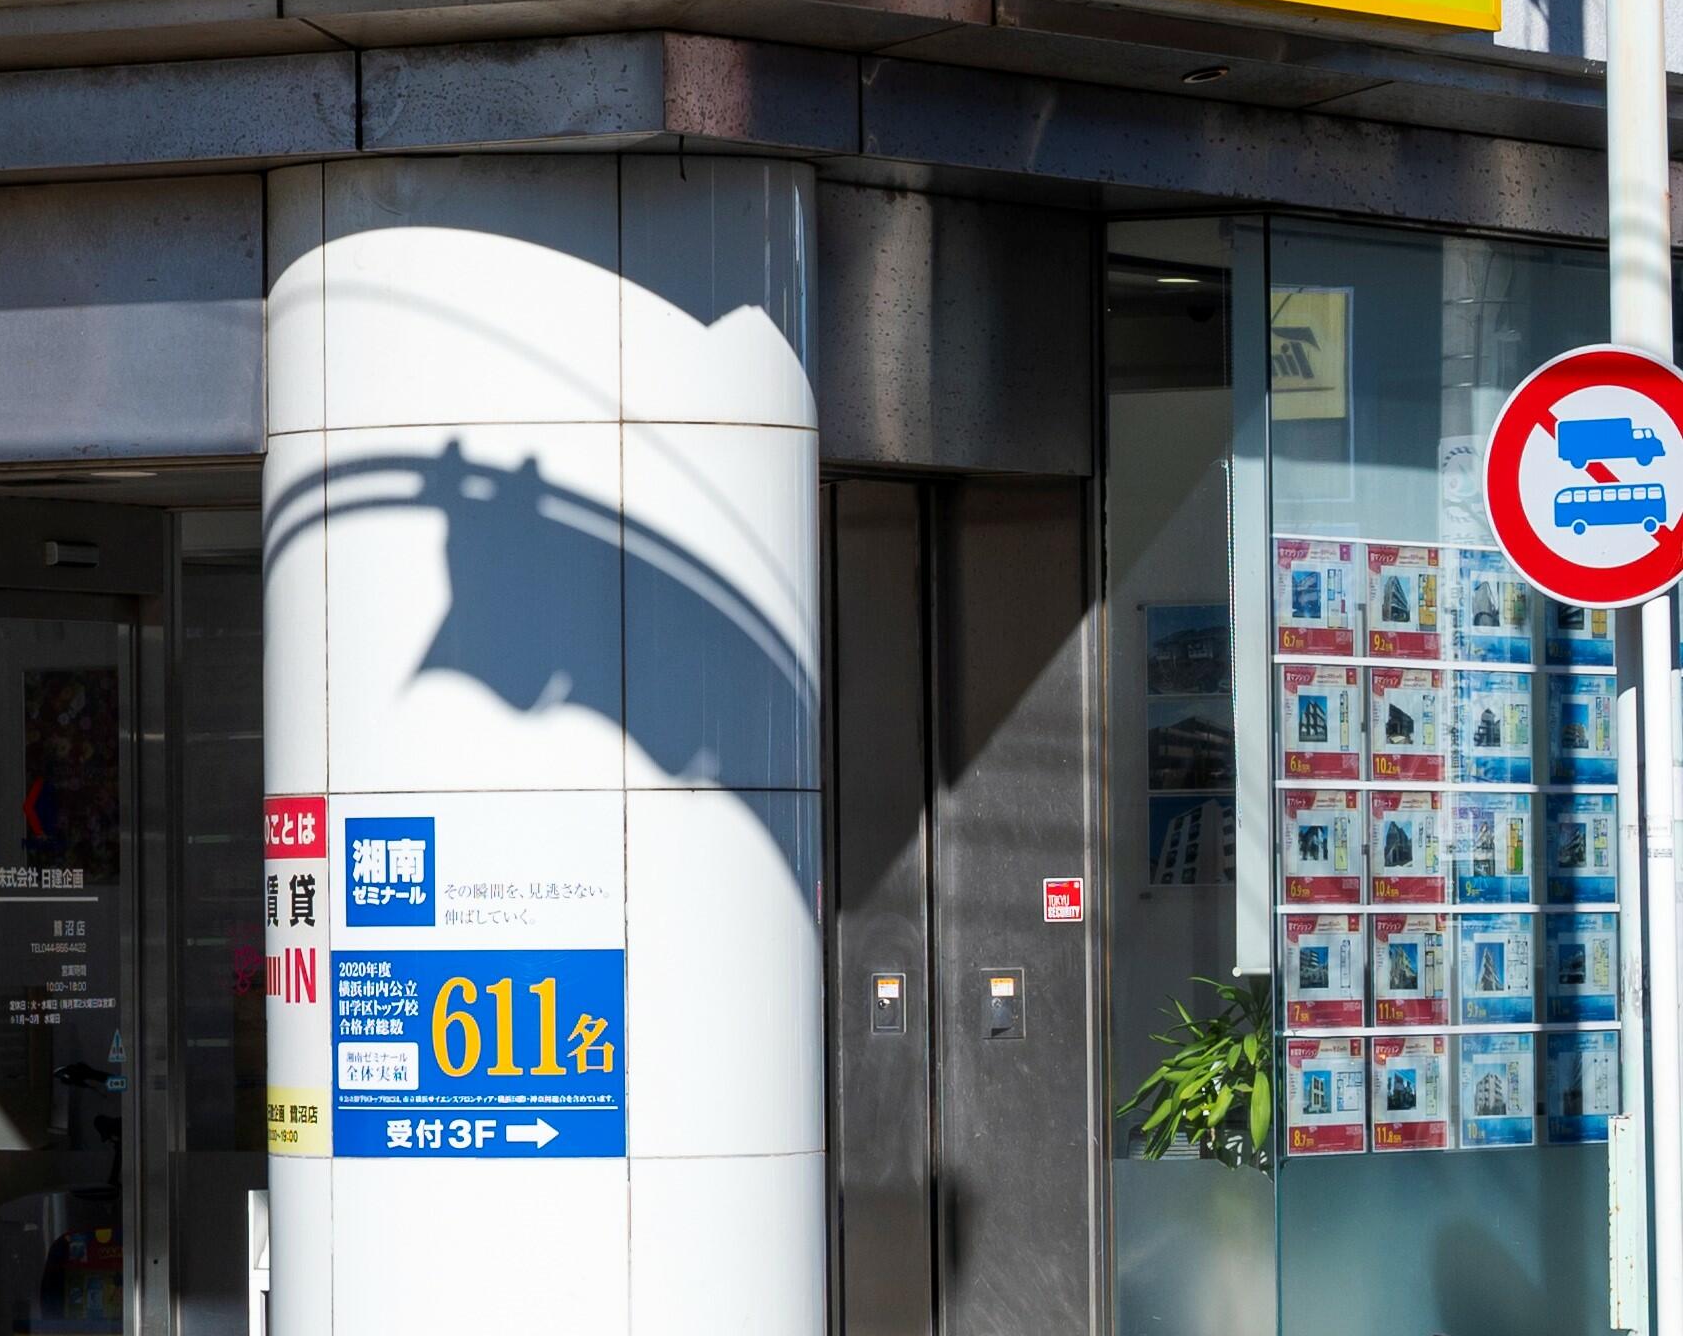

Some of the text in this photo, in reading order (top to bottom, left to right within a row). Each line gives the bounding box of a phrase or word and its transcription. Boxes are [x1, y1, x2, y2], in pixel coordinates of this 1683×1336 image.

[352, 837, 427, 884] 湘南
[41, 867, 84, 889] 日建企画
[352, 885, 427, 906] ゼミナール
[443, 882, 611, 900] その瞬間を、見逃さない。
[443, 908, 536, 926] 伸ばしていく。
[338, 960, 392, 979] 2020年度
[338, 979, 418, 998] 横浜市内公立
[338, 999, 419, 1017] 旧学区トップ校
[338, 1018, 404, 1036] 合格者総数
[346, 1050, 407, 1063] 湘南ゼミナール
[346, 1064, 409, 1082] 全体実績
[386, 1118, 497, 1150] 受付3F
